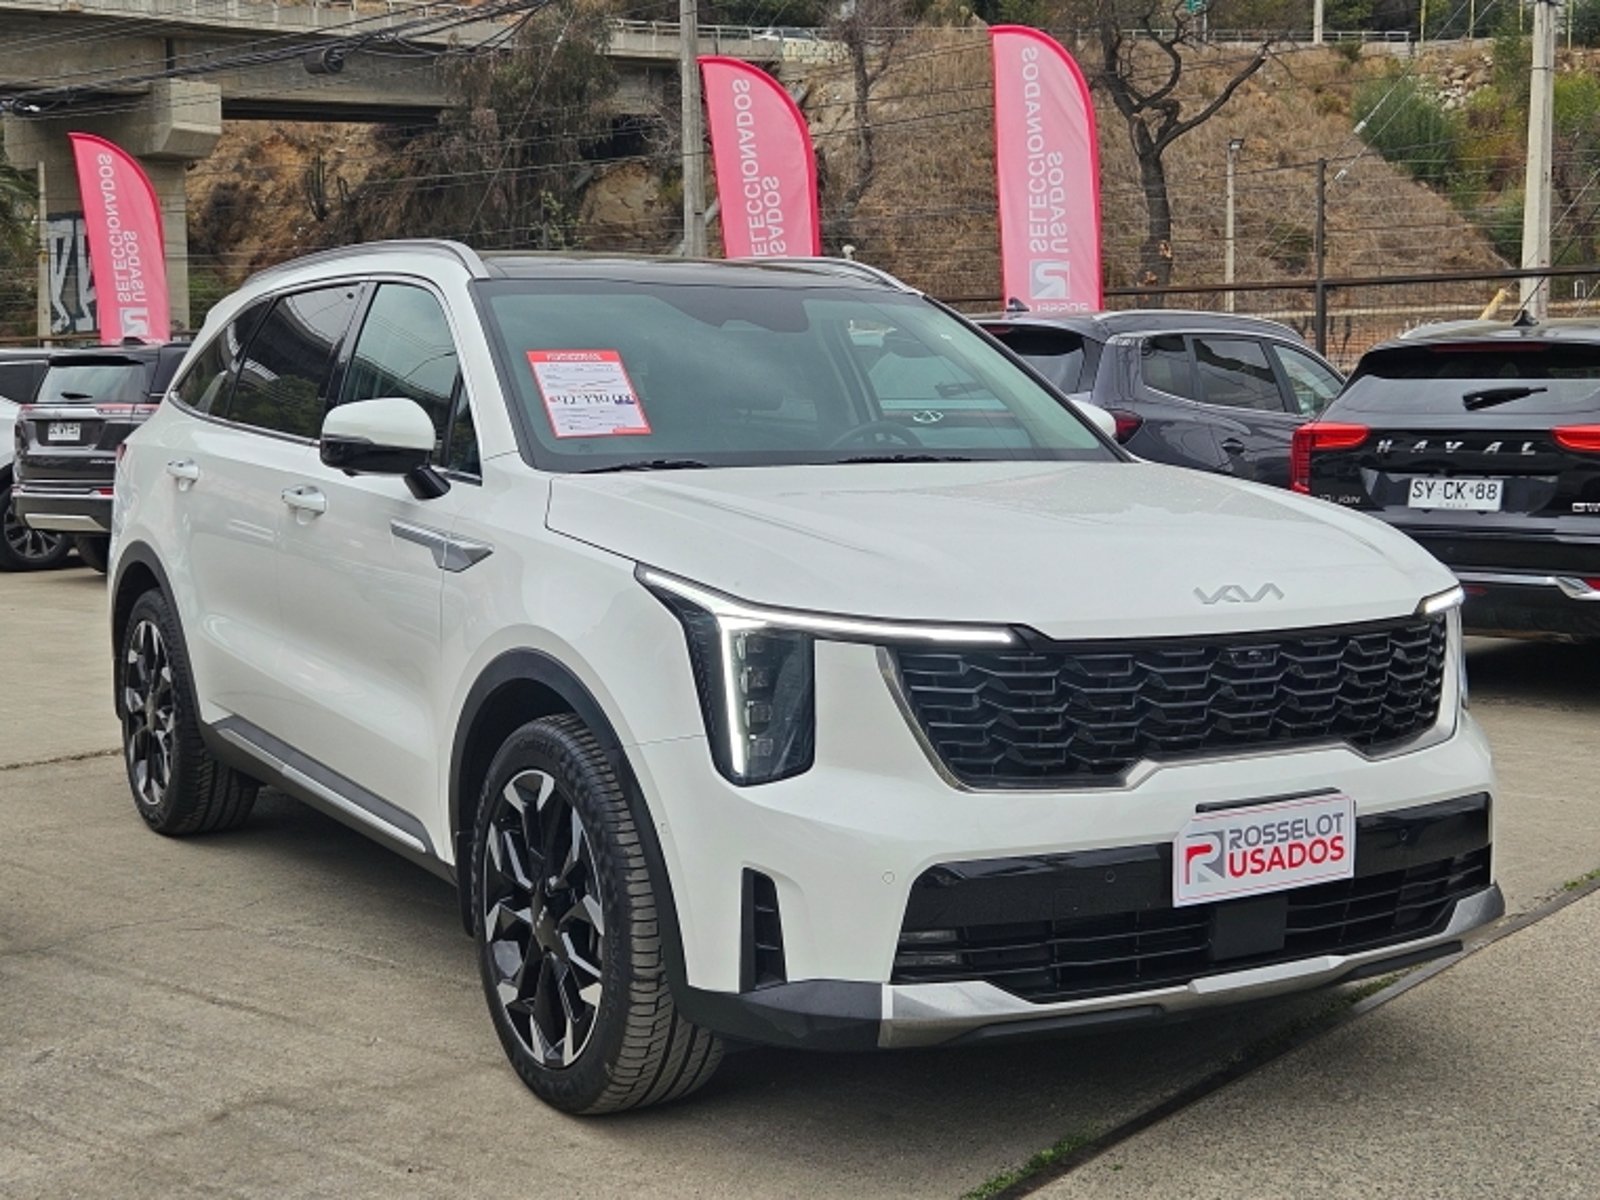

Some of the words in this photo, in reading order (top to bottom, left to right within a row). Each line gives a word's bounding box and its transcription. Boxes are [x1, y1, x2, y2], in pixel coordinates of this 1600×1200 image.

[1376, 440, 1536, 455] HAVAL
[1193, 583, 1284, 604] KIA
[1229, 812, 1344, 850] ROSSELOT
[1229, 836, 1344, 878] USADOS
